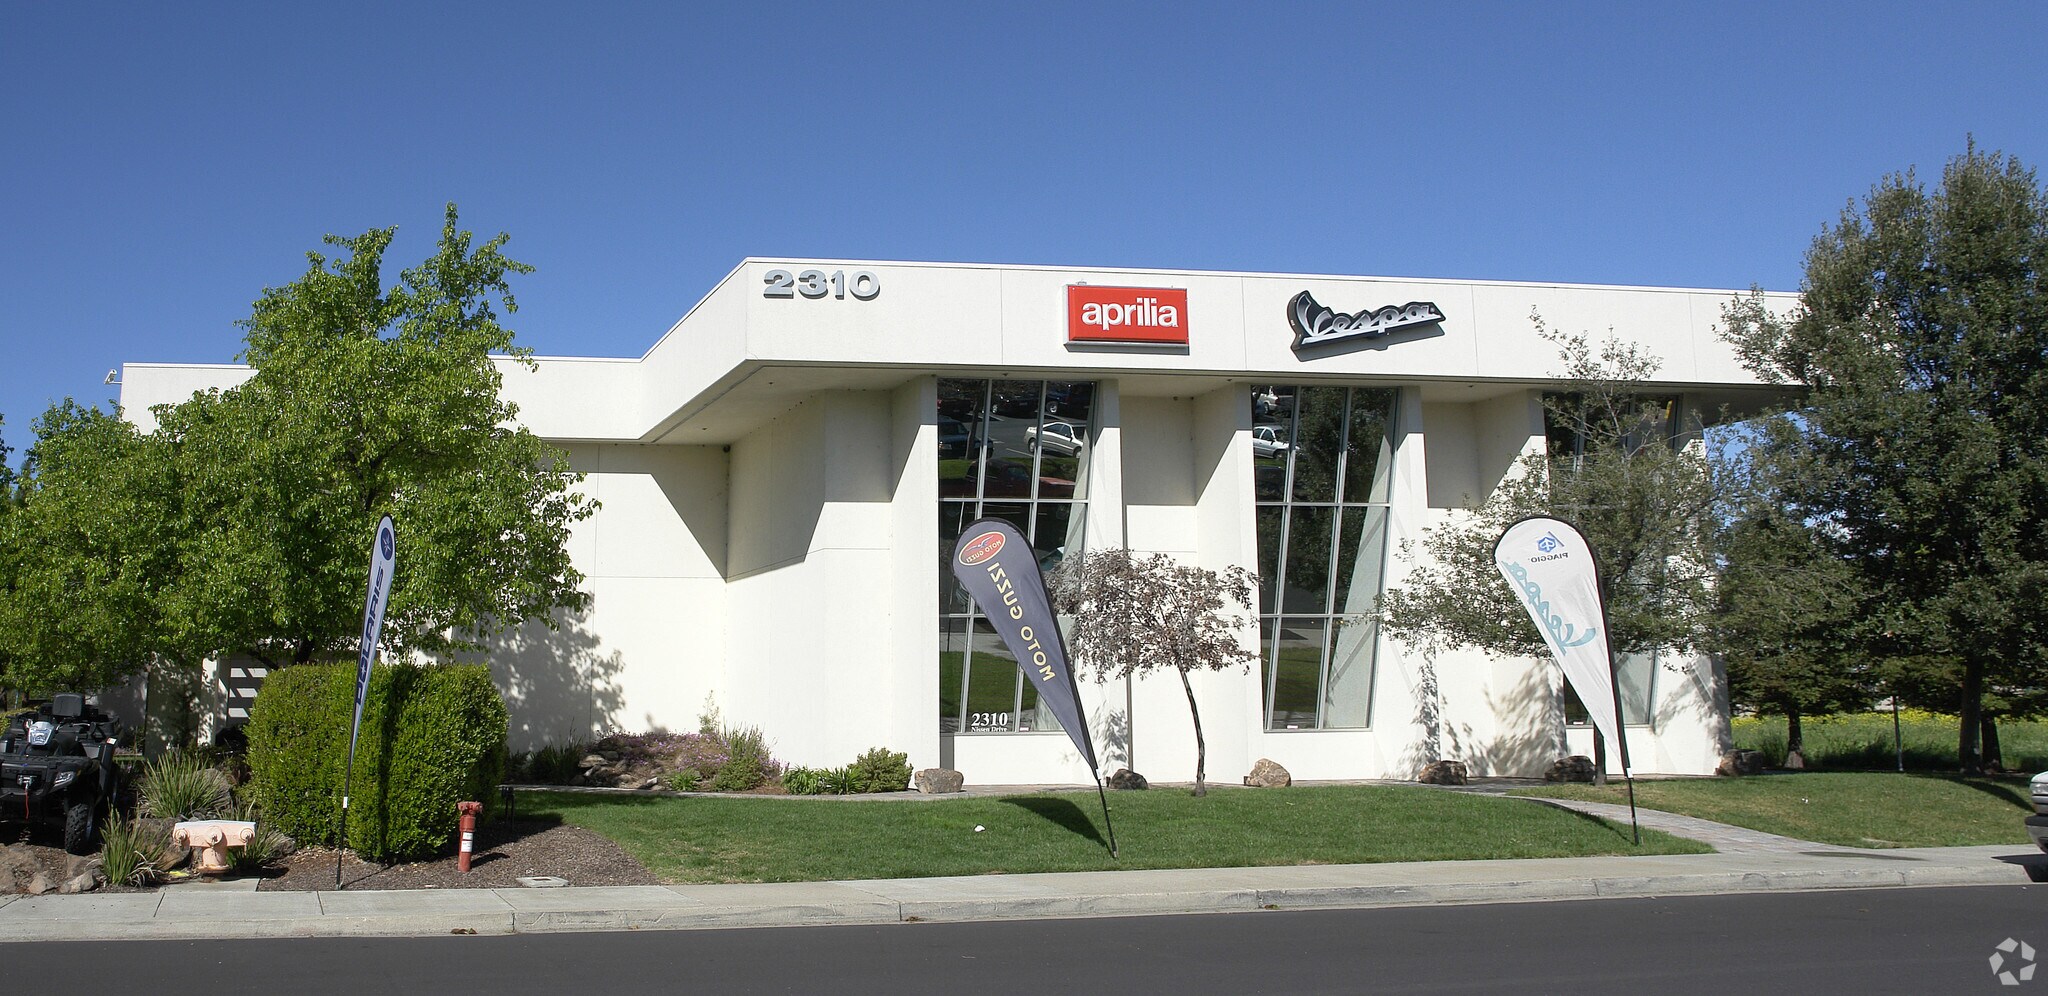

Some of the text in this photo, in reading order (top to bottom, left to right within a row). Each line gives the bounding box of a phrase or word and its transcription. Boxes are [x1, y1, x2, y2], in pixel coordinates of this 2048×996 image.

[763, 269, 880, 301] 2310
[1081, 297, 1179, 331] aprilia
[1296, 294, 1442, 345] Vespa
[355, 565, 384, 705] POLARIS
[971, 712, 1008, 727] 2310
